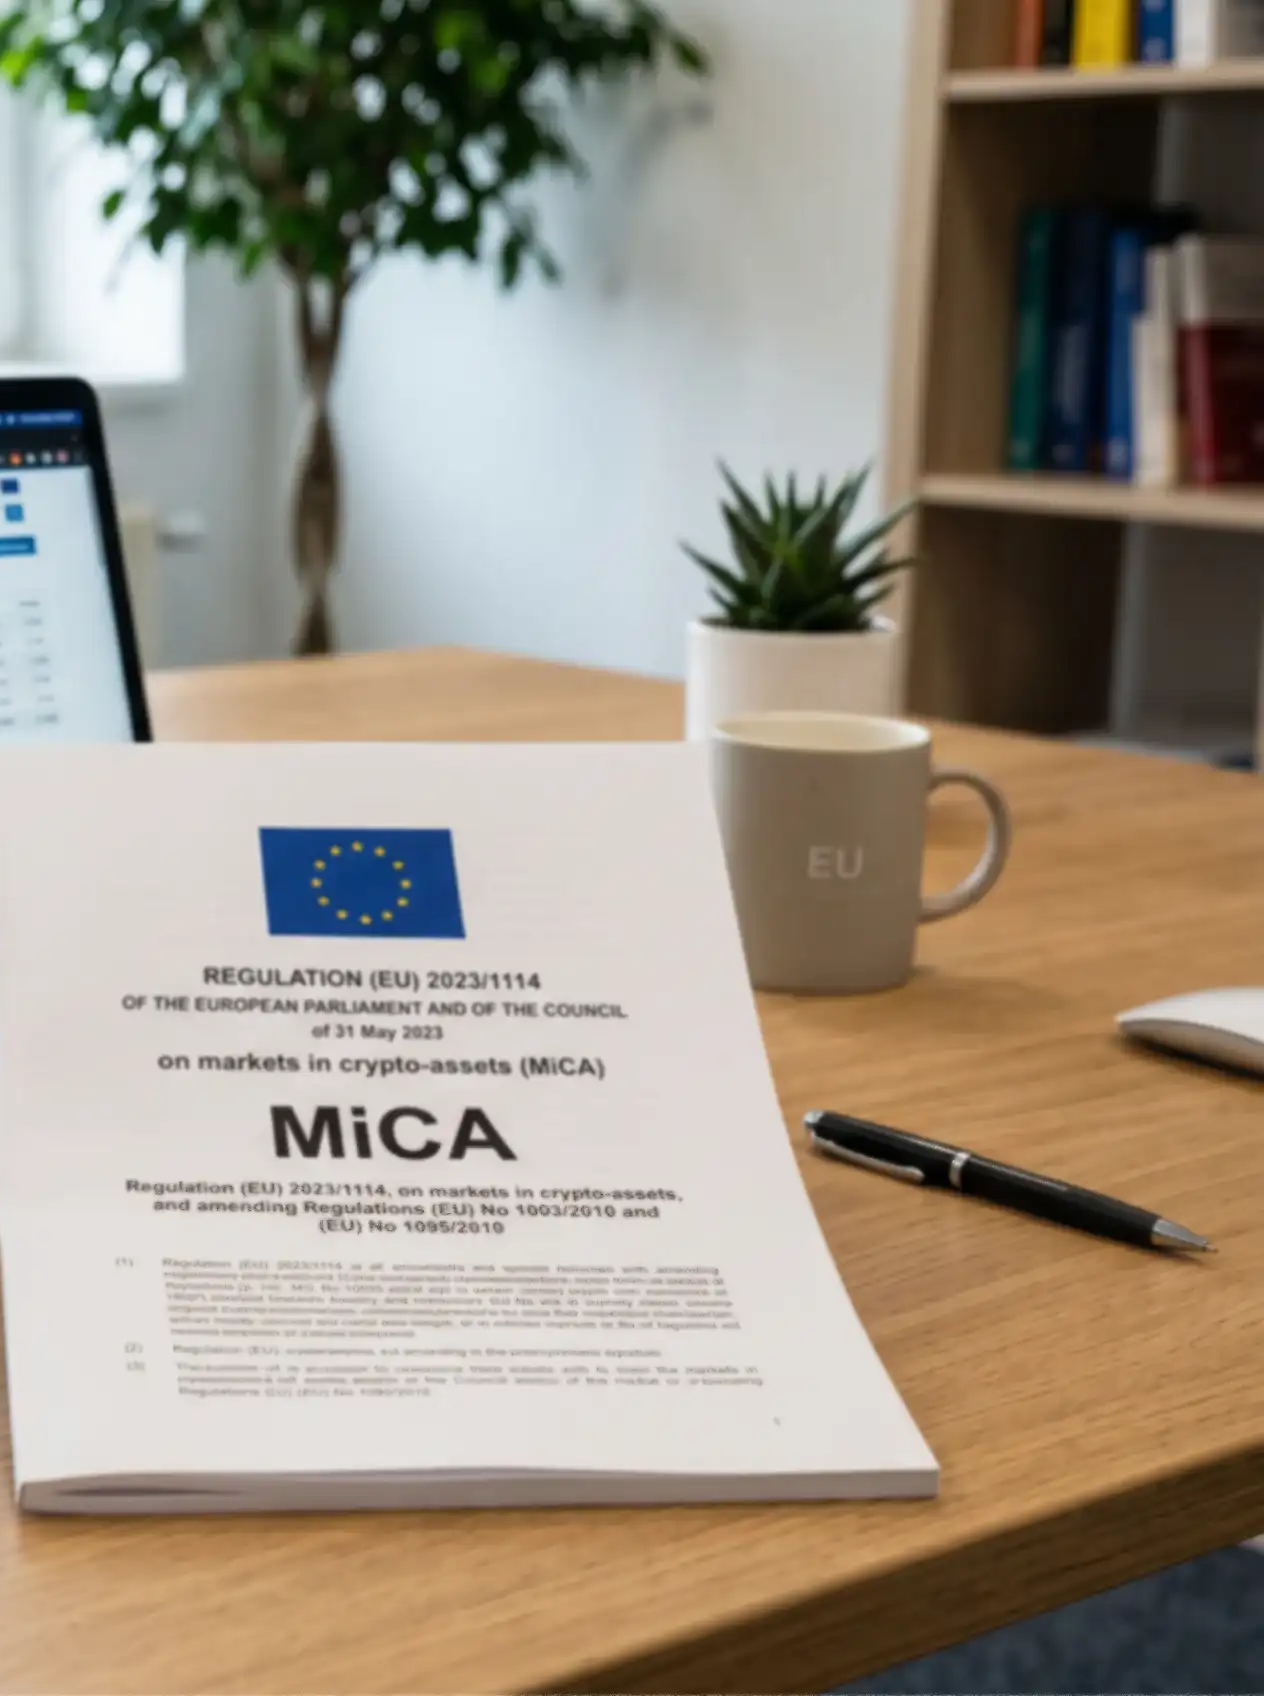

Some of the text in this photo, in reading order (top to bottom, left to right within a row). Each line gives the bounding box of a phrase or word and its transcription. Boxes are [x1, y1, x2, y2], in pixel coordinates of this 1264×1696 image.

[808, 845, 864, 879] EU
[203, 966, 542, 992] REGULATION (EU) 2023/1114
[122, 994, 628, 1018] OF THE EUROPEAN PARLIAMENT AND OF THE COUNCIL
[312, 1024, 444, 1042] of 31 May 2023
[157, 1052, 606, 1080] on markets in crypto-assets (MiCA)
[270, 1104, 518, 1161] MiCA
[126, 1179, 235, 1199] Regulation
[240, 1181, 283, 1198] (EU)
[398, 1185, 424, 1198] on
[430, 1185, 509, 1199] markets
[515, 1184, 534, 1199] in
[540, 1186, 683, 1203] crypto-assets,
[153, 1199, 190, 1212] and
[197, 1199, 298, 1216] amending
[303, 1201, 425, 1218] Regulations
[431, 1203, 475, 1219] (EU)
[481, 1203, 509, 1217] No
[622, 1205, 660, 1219] and
[318, 1218, 363, 1235] (EU)
[368, 1219, 397, 1233] No
